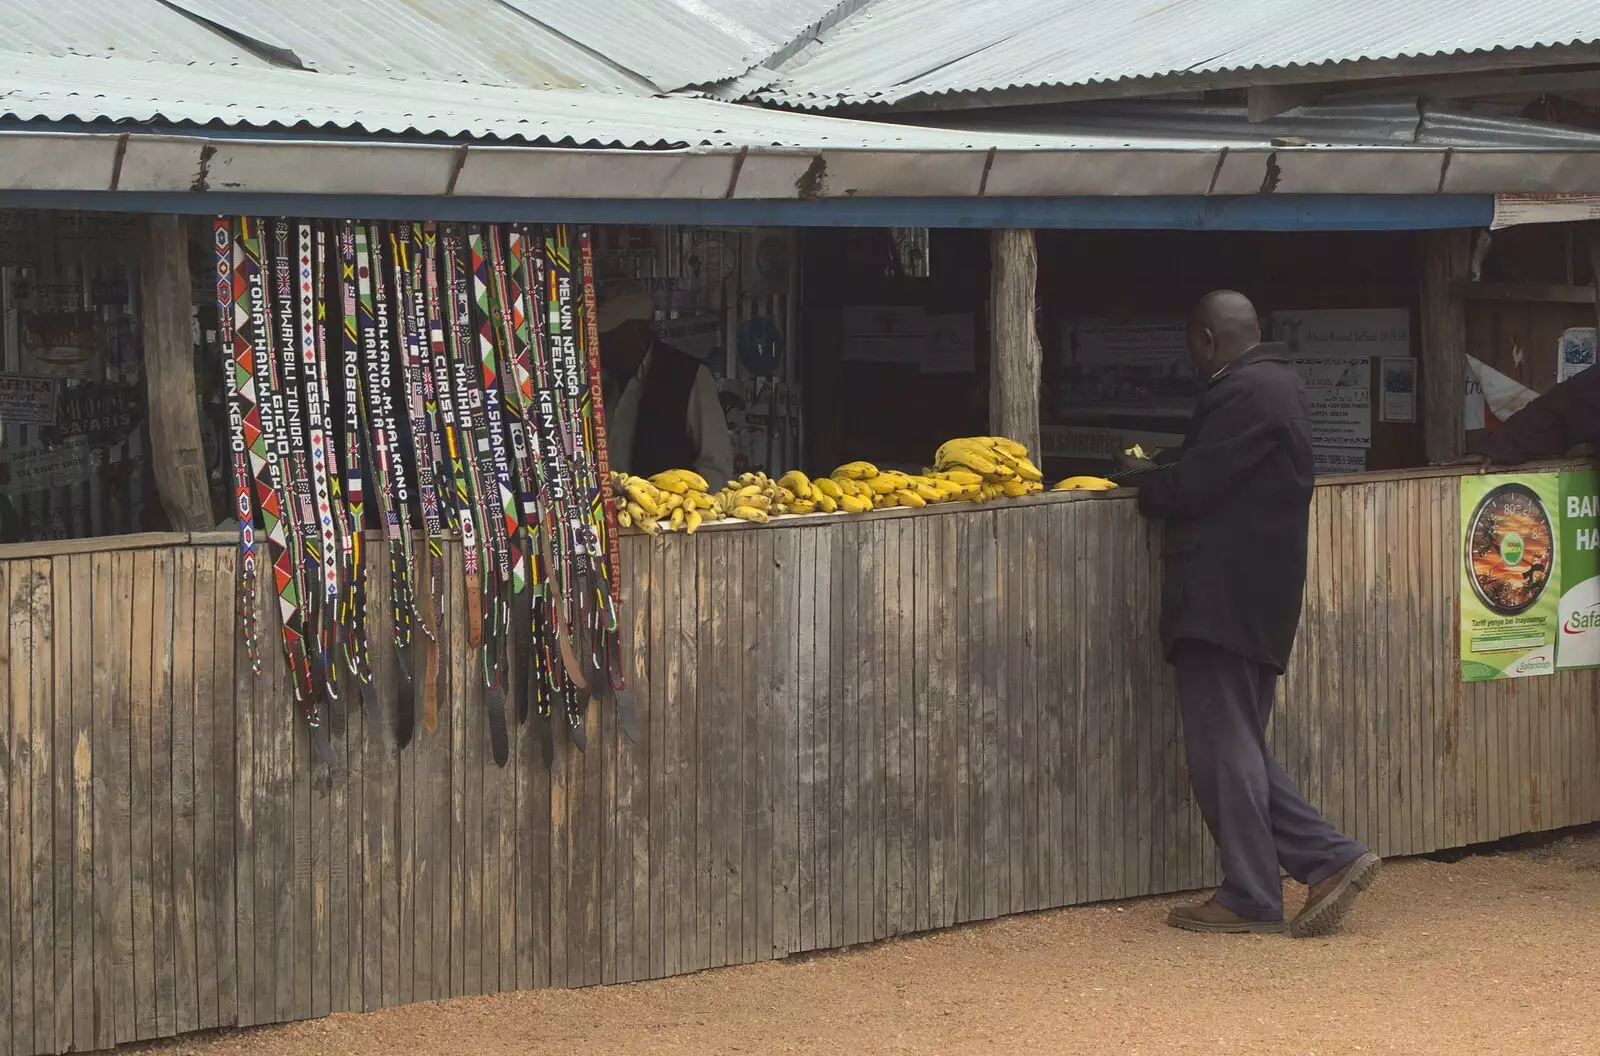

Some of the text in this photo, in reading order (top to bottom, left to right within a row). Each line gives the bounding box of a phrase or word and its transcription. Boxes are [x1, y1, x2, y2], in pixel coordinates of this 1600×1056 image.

[582, 243, 593, 277] THE
[414, 292, 429, 363] MUSHIRI
[559, 277, 579, 396] MELVIN NJENGA
[584, 283, 598, 359] GUNNERS
[222, 342, 244, 452] JOHN KEMO
[280, 300, 303, 446] MWAMBILI JUNIOR
[305, 364, 321, 426] JESSE
[345, 350, 358, 430] ROBERT
[435, 355, 455, 424] CHRISS
[455, 363, 472, 428] MWIHIA
[551, 335, 564, 388] FELIX
[590, 372, 602, 409] TOM
[272, 394, 289, 455] GICHO
[377, 303, 390, 388] HALKANO
[385, 417, 408, 500] HALKANO
[485, 389, 510, 482] M.SHARIFF
[540, 390, 563, 498] KENYATTA
[595, 426, 614, 504] ARSENAL
